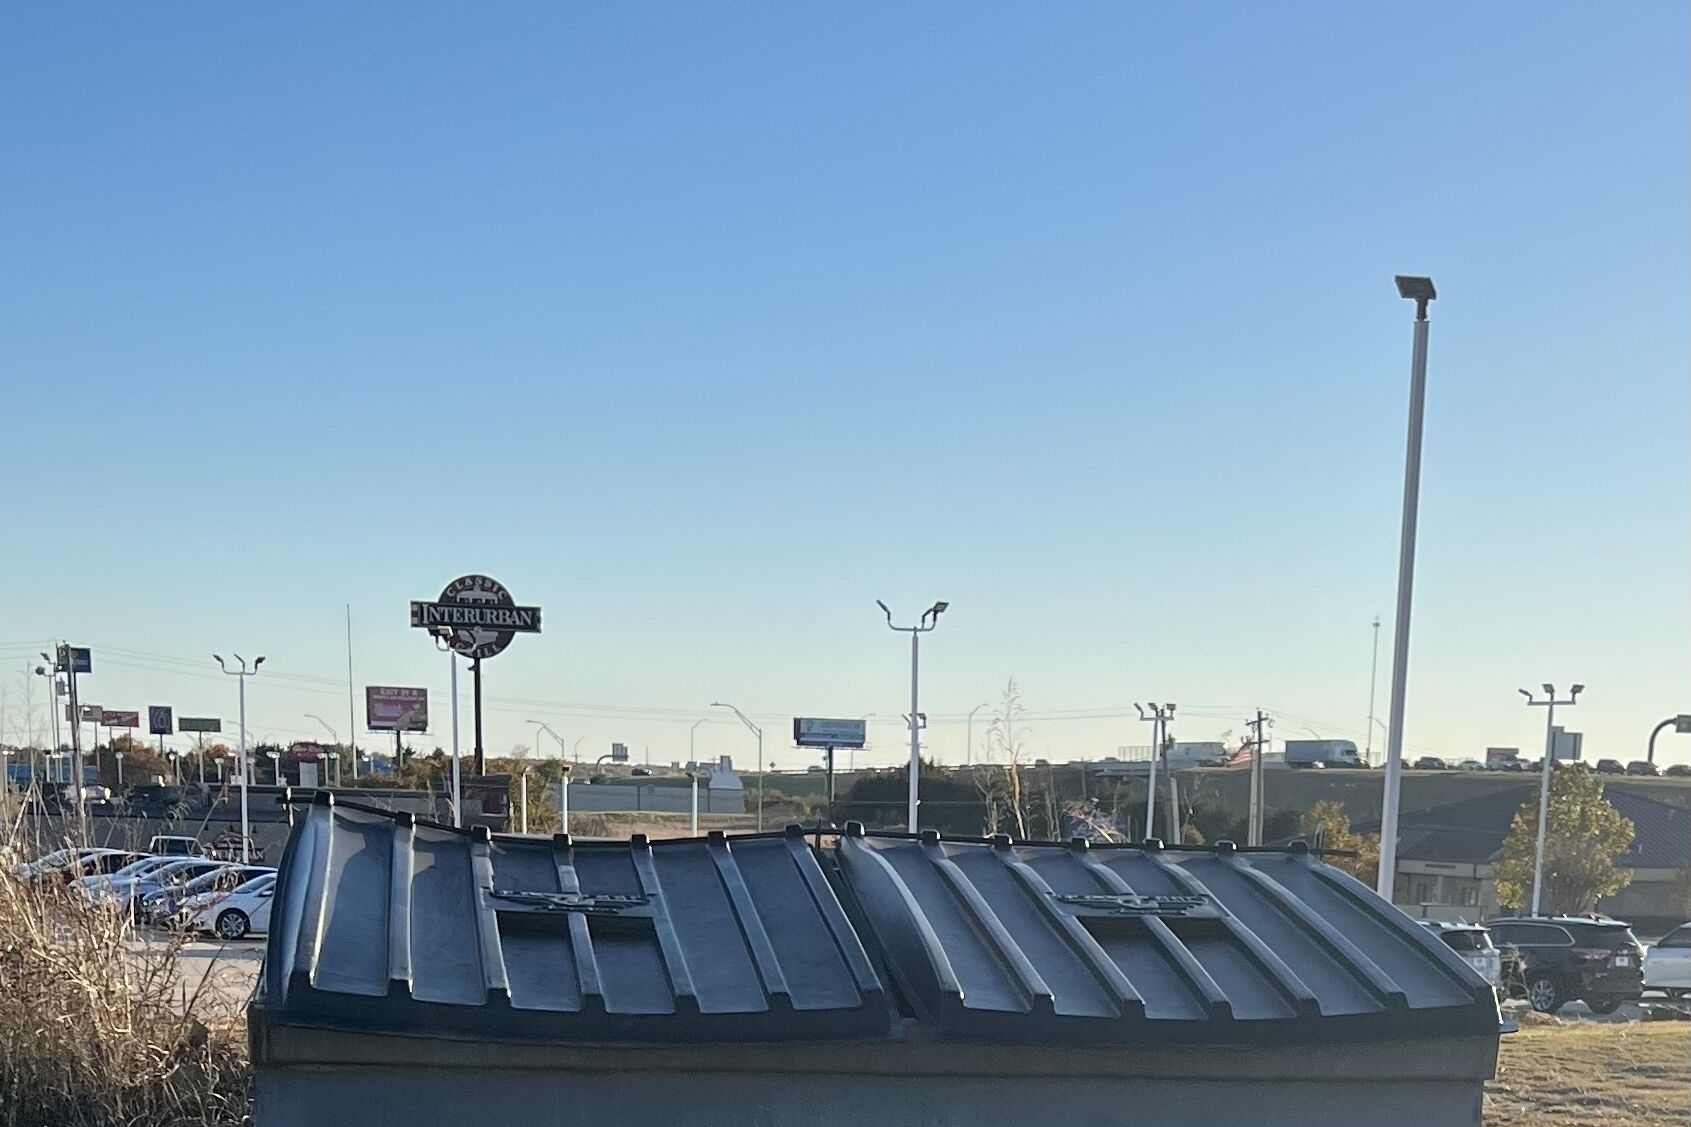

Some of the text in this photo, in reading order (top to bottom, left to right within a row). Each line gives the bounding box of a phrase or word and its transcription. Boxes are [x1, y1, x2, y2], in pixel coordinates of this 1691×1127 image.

[446, 577, 508, 600] CLASSIC
[422, 604, 532, 626] INTERURBAN
[455, 642, 502, 658] GILL
